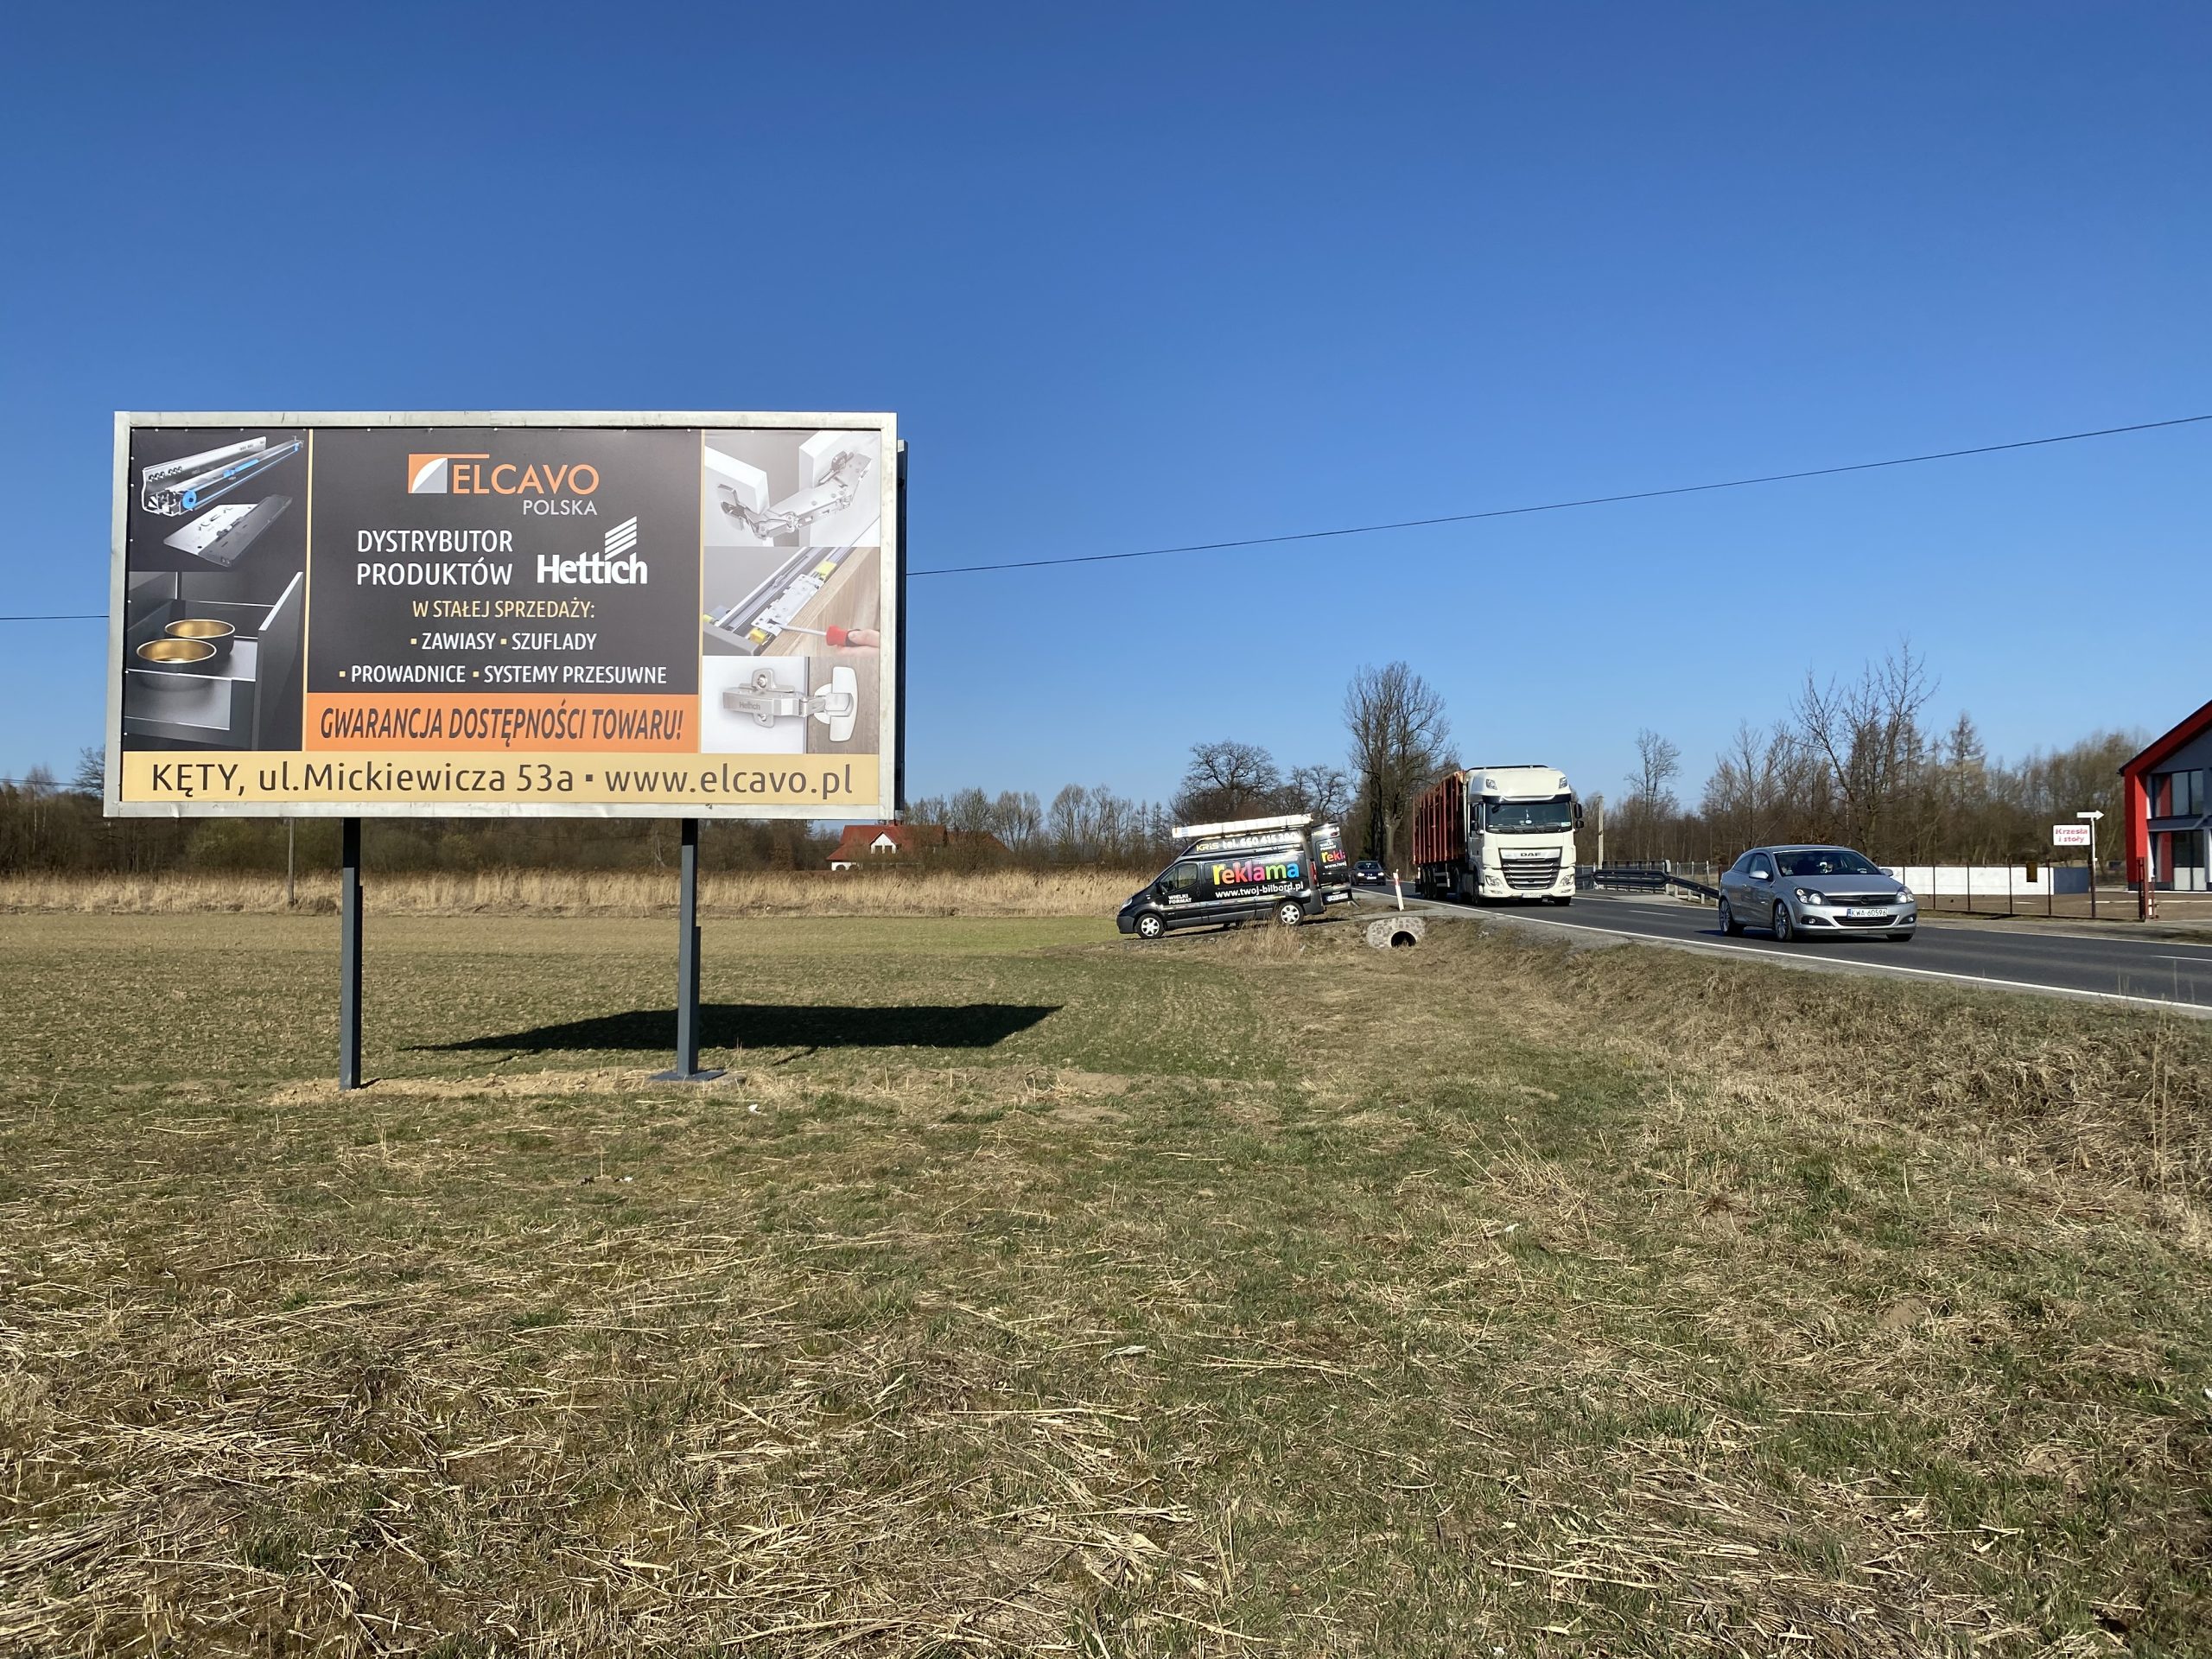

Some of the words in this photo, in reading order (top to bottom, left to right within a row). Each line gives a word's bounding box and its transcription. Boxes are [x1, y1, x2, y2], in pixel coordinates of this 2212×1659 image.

[452, 463, 600, 495] ELCAVO
[523, 499, 598, 516] POLSKA
[357, 529, 513, 553] DYSTRYBUTOR
[357, 556, 512, 586] PRODUKTÓW
[537, 550, 648, 584] Hettich
[412, 601, 429, 618] W
[433, 601, 491, 618] STAŁEJ
[494, 596, 595, 619] SPRZEDAŻY:
[421, 632, 496, 650] ZAWIASY
[512, 632, 597, 651] SZUFLADY
[351, 664, 466, 683] PROWADNICE
[483, 664, 558, 683] SYSTEMY
[563, 665, 667, 684] PRZESUWNE
[321, 707, 443, 740] GWARANCJA
[448, 700, 586, 747] DOSTĘPNOŚCI
[592, 708, 683, 741] TOWARU!
[152, 763, 245, 798] KĘTY,
[259, 760, 506, 792] ul.Mickiewicza
[517, 764, 574, 792] 53a
[605, 762, 853, 800] www.elcavo.pl
[1222, 838, 1238, 849] tel.
[1212, 861, 1300, 886] reklama
[1215, 880, 1304, 899] www.twoj-bilbord.pl
